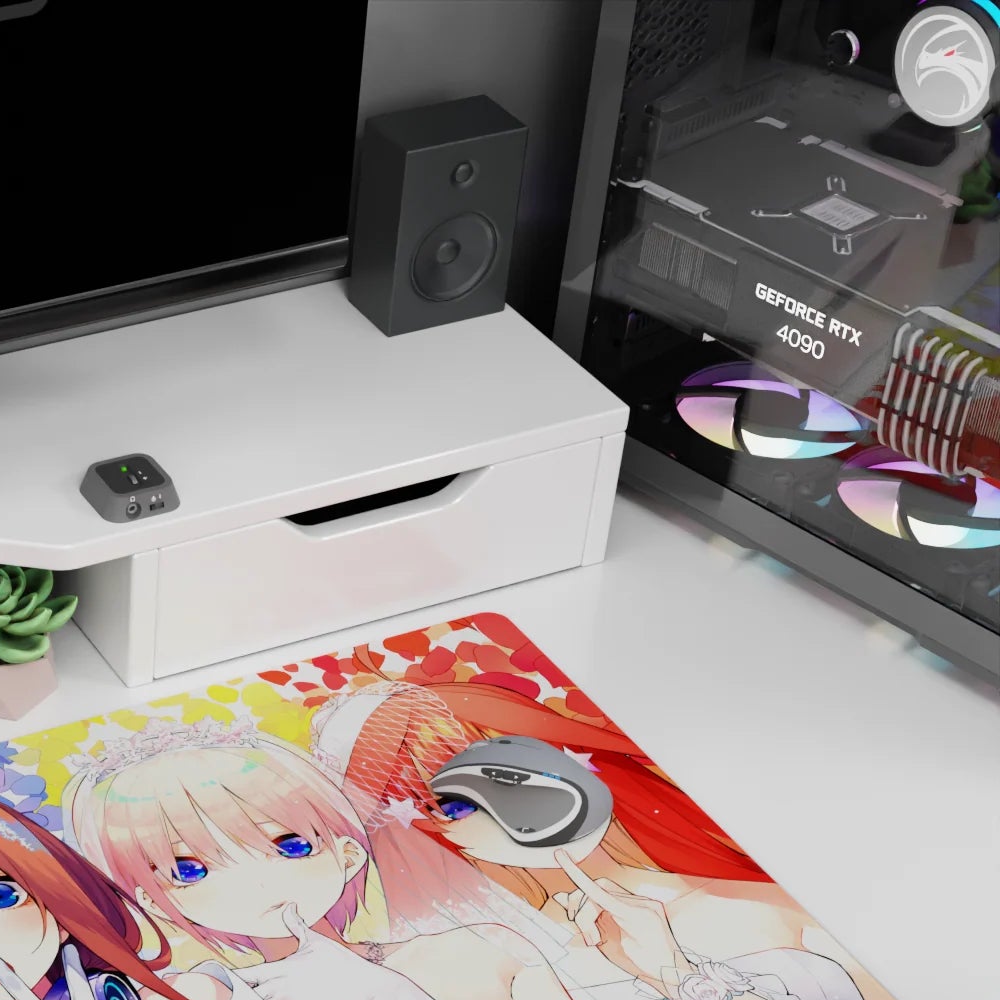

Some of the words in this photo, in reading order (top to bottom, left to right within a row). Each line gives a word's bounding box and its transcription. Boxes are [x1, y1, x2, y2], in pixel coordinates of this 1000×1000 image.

[754, 282, 827, 329] GEFORCE
[828, 318, 864, 347] RTX
[776, 324, 826, 360] 4090
